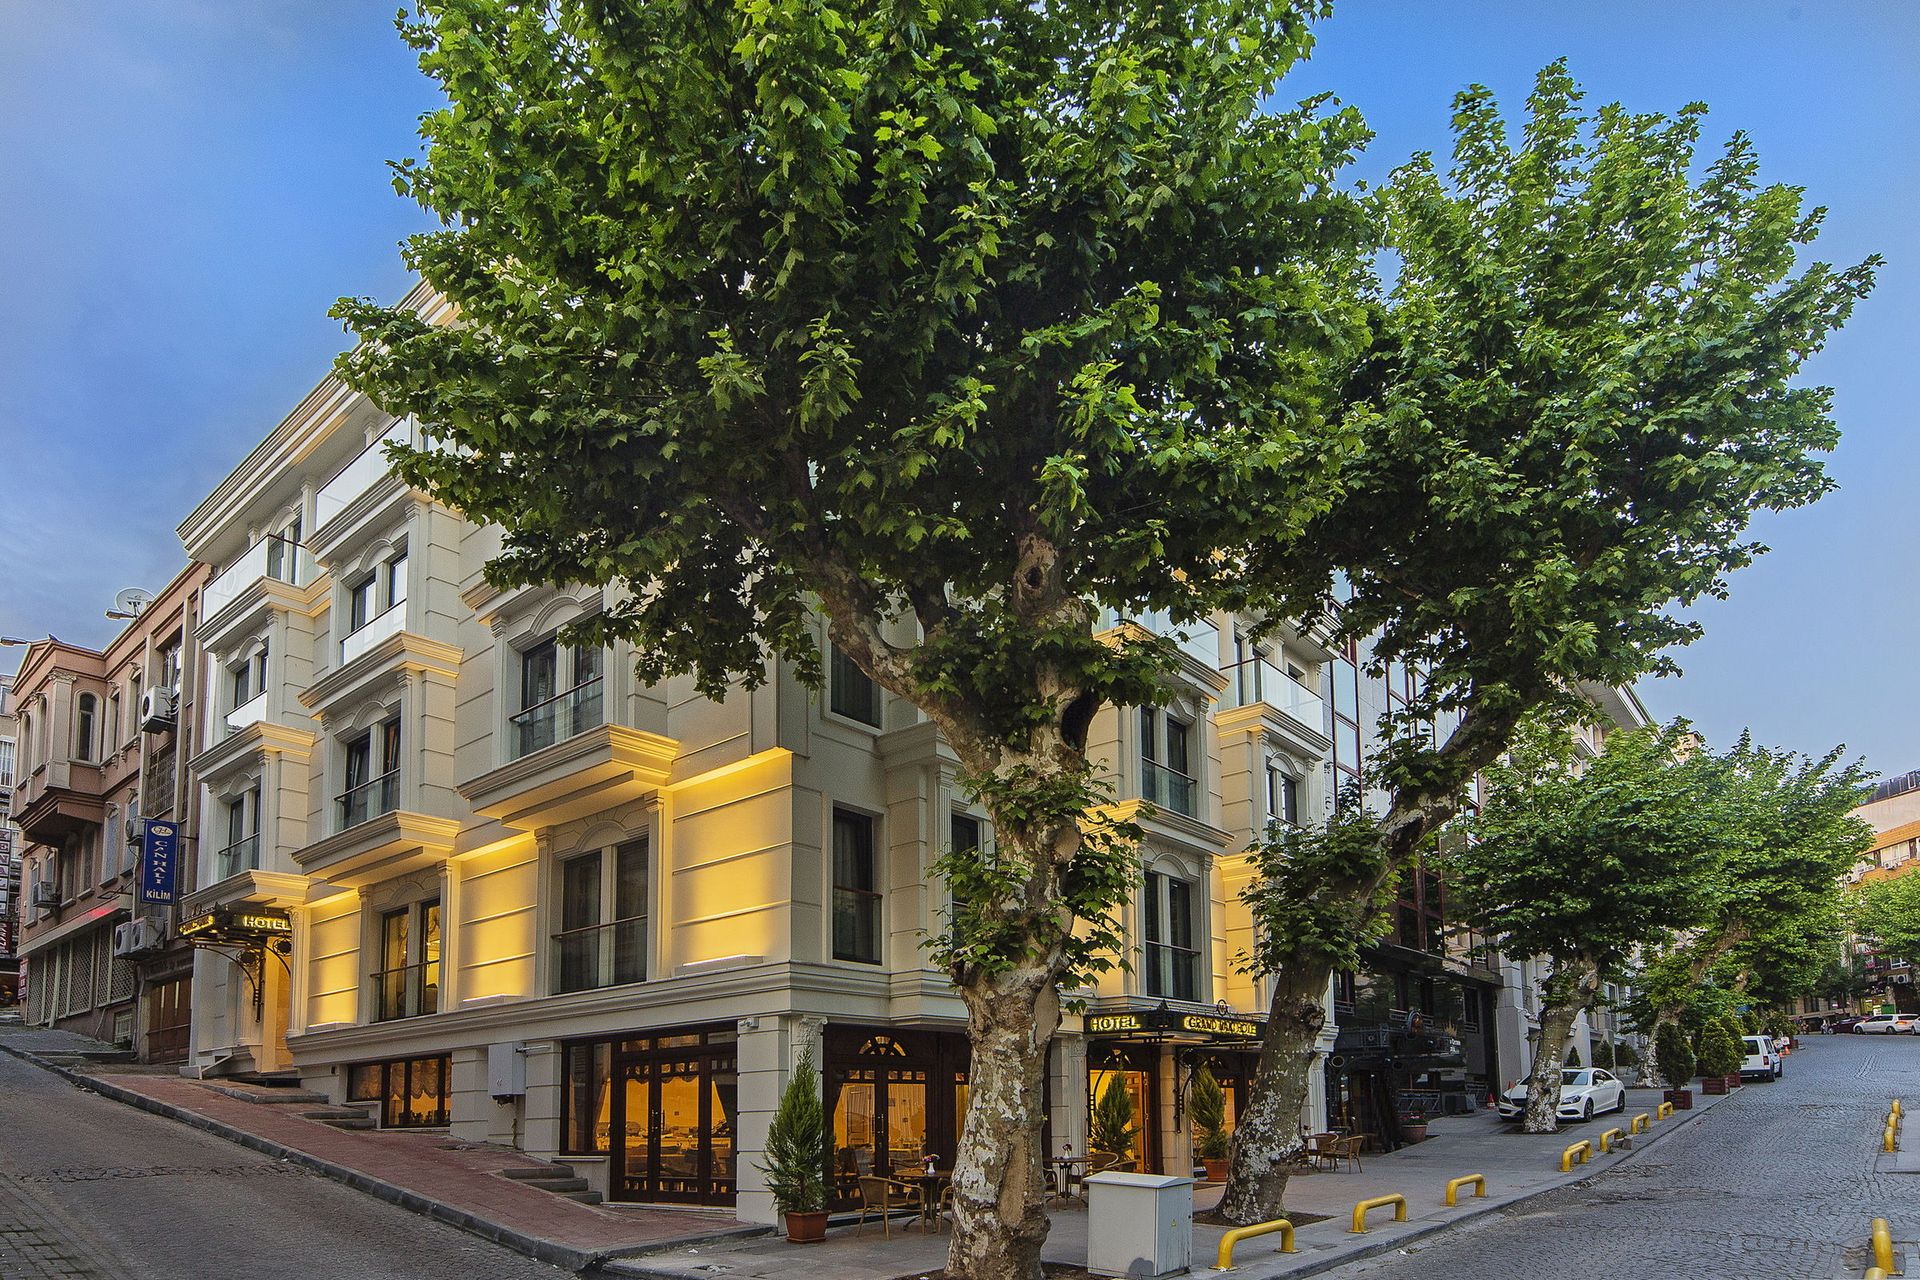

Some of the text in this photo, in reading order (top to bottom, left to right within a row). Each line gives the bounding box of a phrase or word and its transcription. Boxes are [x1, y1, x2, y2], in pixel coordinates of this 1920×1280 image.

[243, 915, 291, 930] HOTEL
[1090, 1016, 1141, 1031] HOTEL
[1188, 1016, 1217, 1031] GRAND
